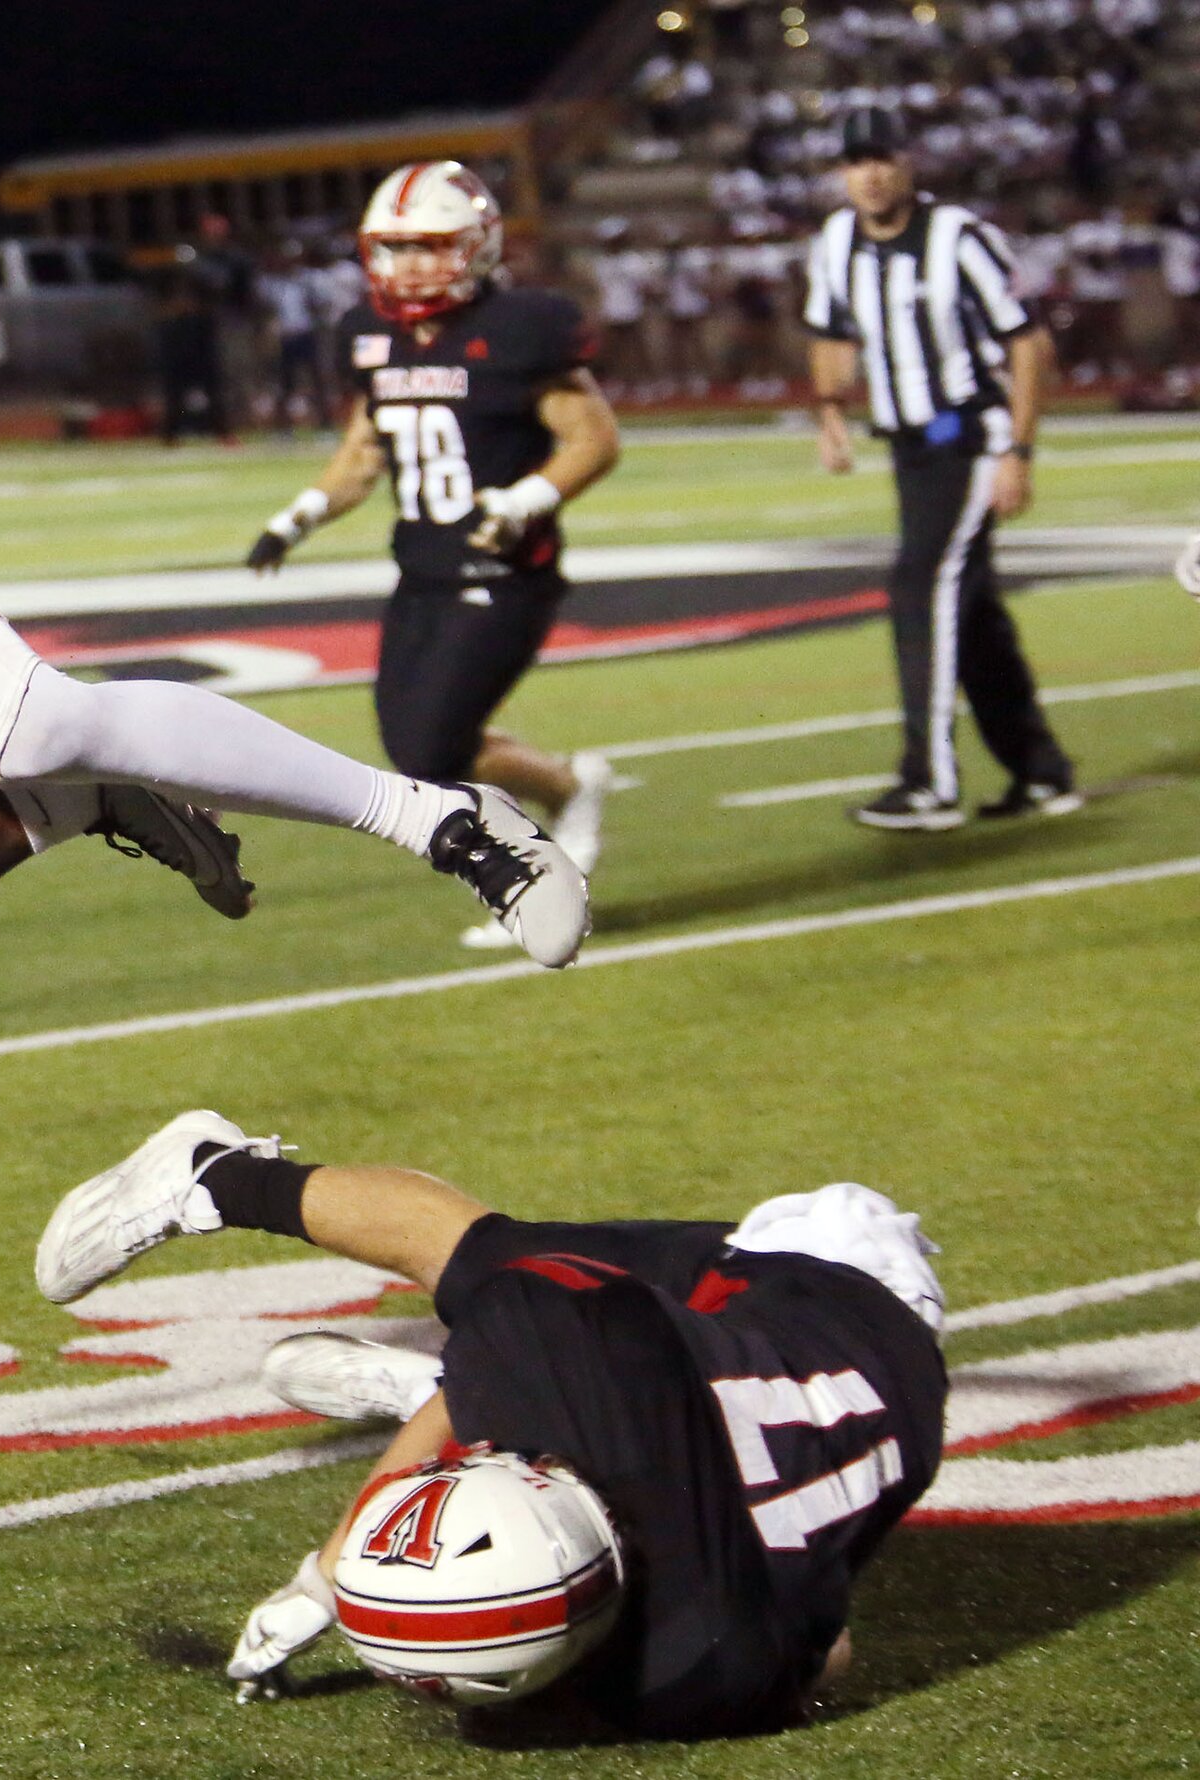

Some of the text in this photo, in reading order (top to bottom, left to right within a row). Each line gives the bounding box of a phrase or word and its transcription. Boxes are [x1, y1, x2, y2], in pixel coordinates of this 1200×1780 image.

[374, 404, 474, 525] 78
[709, 1367, 904, 1550] 17
[360, 1474, 461, 1571] V
